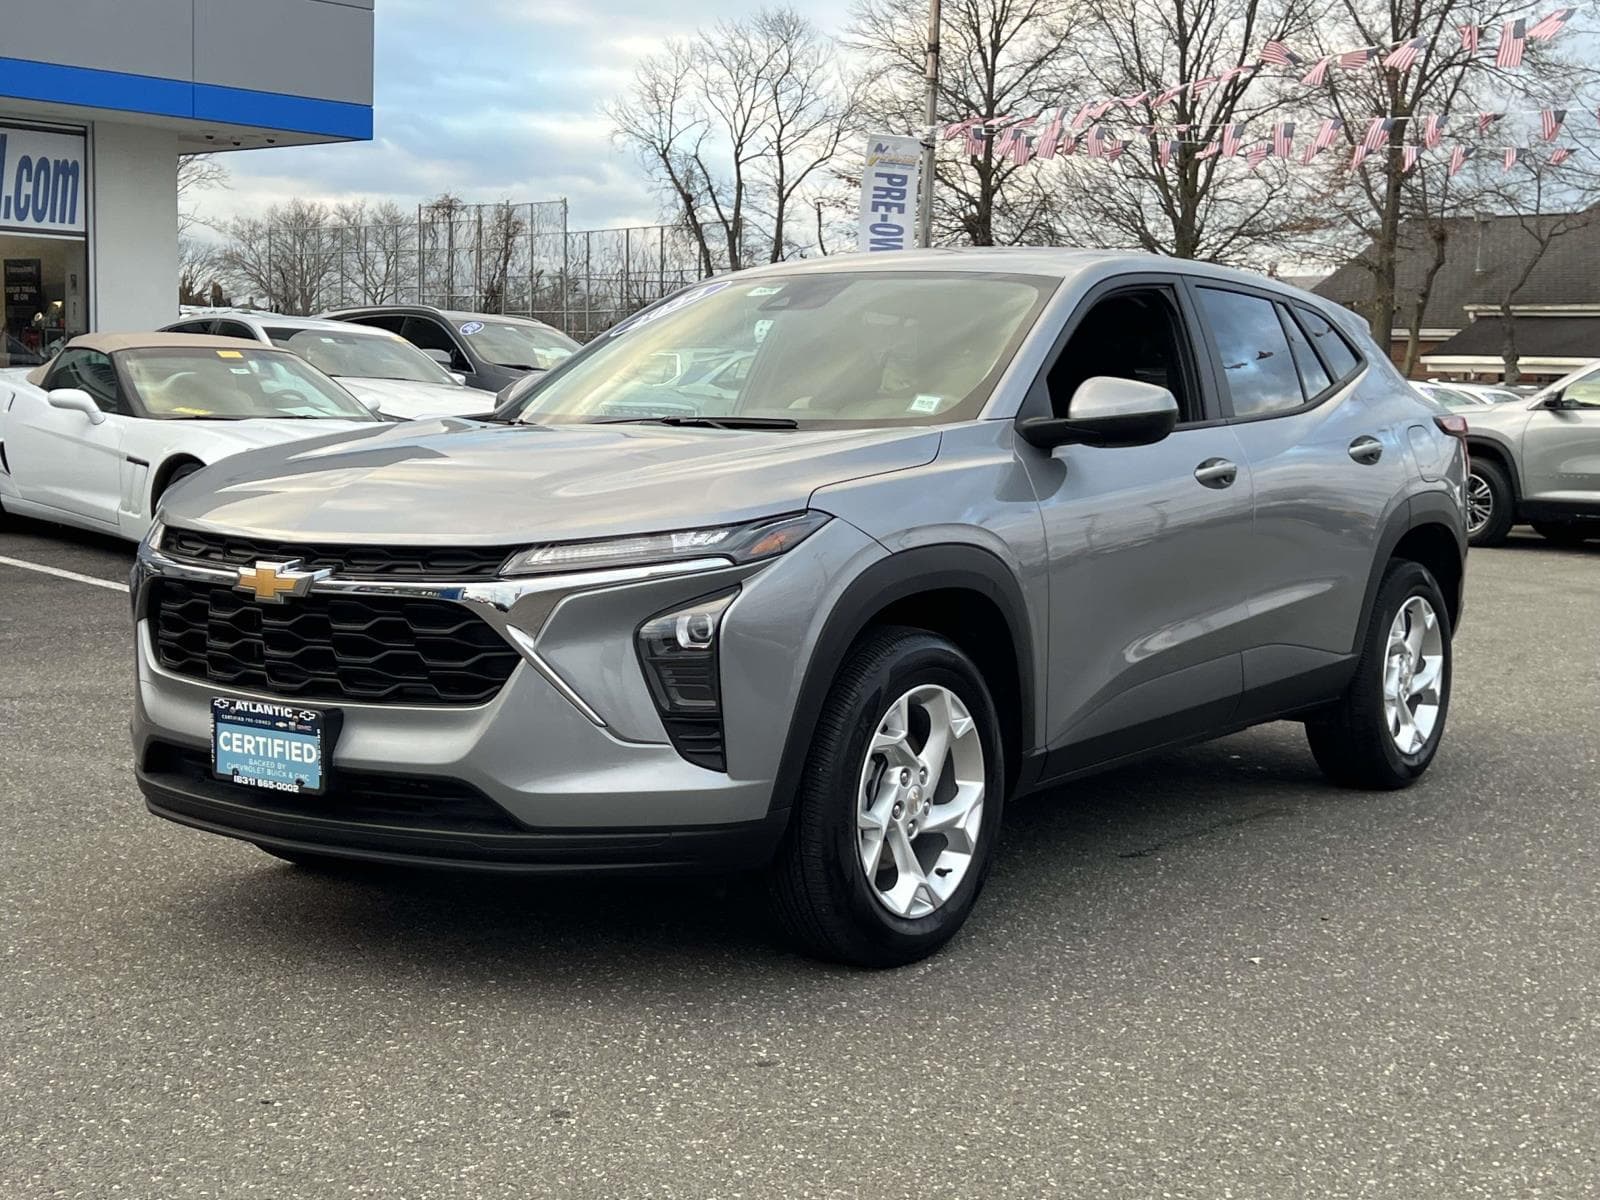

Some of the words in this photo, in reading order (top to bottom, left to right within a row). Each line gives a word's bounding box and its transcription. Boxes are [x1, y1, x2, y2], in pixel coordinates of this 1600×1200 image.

[235, 700, 293, 718] ATLANTIC
[219, 731, 317, 764] CERTIFIED
[226, 762, 265, 774] CHEVROLET
[266, 768, 287, 778] BUICK
[248, 758, 275, 769] BACKED
